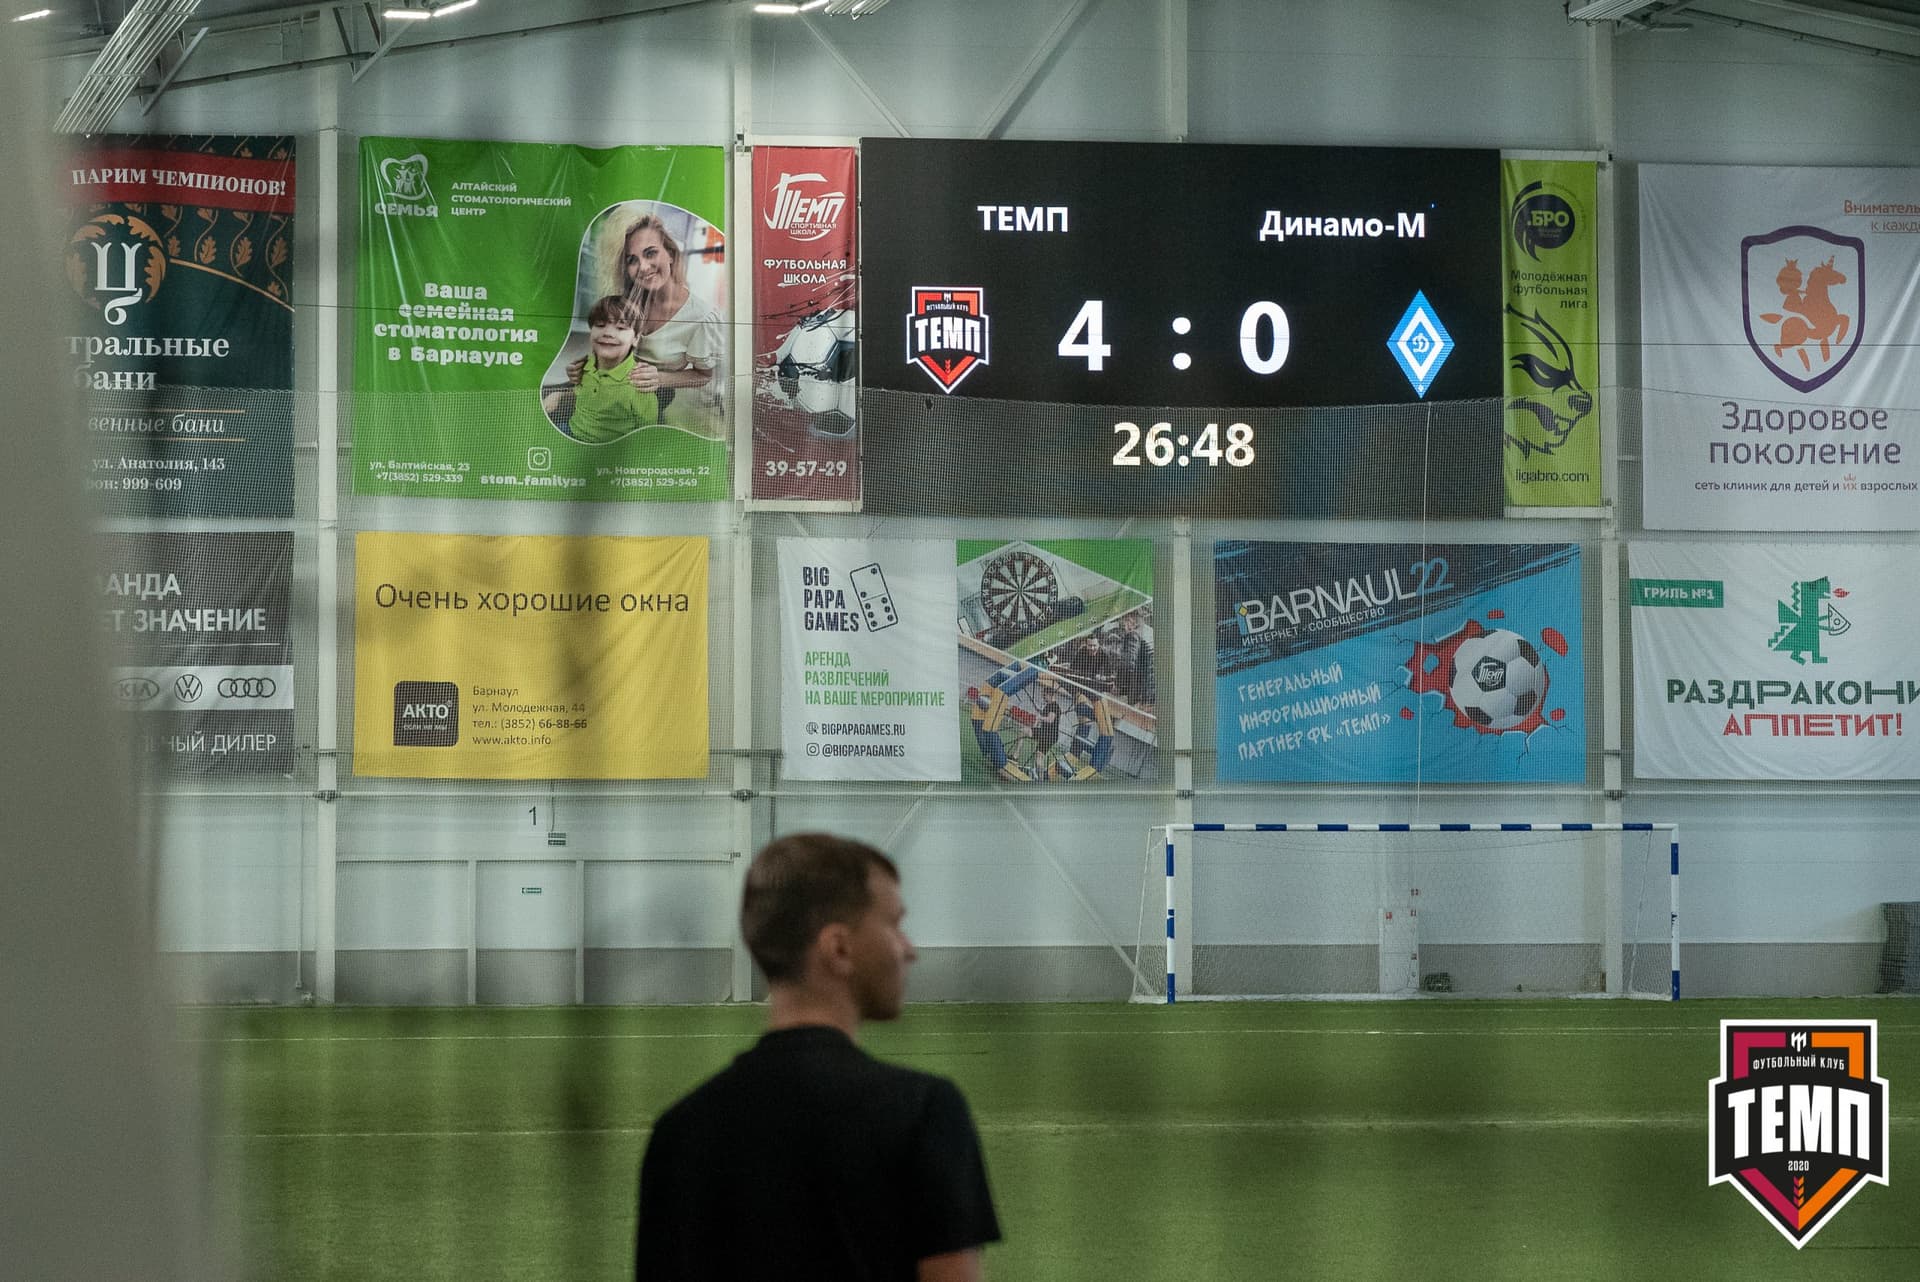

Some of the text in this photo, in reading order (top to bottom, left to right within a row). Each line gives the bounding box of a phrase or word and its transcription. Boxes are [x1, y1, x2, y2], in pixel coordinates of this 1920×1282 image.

[72, 168, 286, 196] ПАРИМ ЧЕМПИОНОВ!
[451, 182, 517, 193] АЛТАЙСКИЙ
[451, 195, 572, 206] СТОМАТОЛОГИЧЕСКИЙ
[374, 203, 439, 218] СЕМЬЯ
[451, 207, 486, 216] ЦЕНТР
[977, 205, 1069, 232] ТЕМП
[1259, 210, 1426, 242] Динамо-М
[1883, 221, 1920, 232] кажд
[763, 258, 847, 270] ФУТБОЛЬНАЯ
[783, 273, 827, 284] ШКОЛА
[424, 282, 488, 299] Ваша
[1512, 282, 1588, 297] футбольная
[399, 302, 514, 321] семейная
[1560, 300, 1588, 309] лига
[374, 323, 538, 342] стоматология
[915, 316, 980, 353] ТЕМП
[1058, 300, 1111, 371] 4
[1239, 301, 1290, 375] 0
[388, 346, 523, 367] в Барнауле
[172, 414, 225, 433] бани
[1722, 401, 1889, 434] Здоровое
[1112, 422, 1255, 467] 26:48
[1710, 442, 1901, 465] поколение
[118, 457, 198, 471] Анатолия,
[203, 458, 225, 470] 143
[370, 461, 385, 471] ул.
[615, 466, 695, 477] Новгородская,
[698, 466, 711, 475] 22
[766, 460, 847, 476] 39-57-29
[122, 477, 182, 491] 999-609
[1515, 468, 1590, 485] ligabro.com
[1694, 482, 1720, 491] сеть
[1723, 482, 1767, 491] клиник
[1770, 483, 1791, 493] для
[1794, 479, 1829, 493] детей
[1832, 482, 1840, 491] и
[1860, 482, 1919, 493] взрослых
[803, 566, 830, 587] BIG
[375, 583, 689, 616] Очень хорошие окна
[803, 588, 846, 609] PAPA
[1644, 587, 1688, 599] ГРИЛЬ
[133, 608, 266, 632] ЗНАЧЕНИЕ
[804, 611, 860, 632] GAMES
[1241, 626, 1299, 647] ИНТЕРНЕТ
[1308, 606, 1385, 633] СООБЩЕСТВО
[805, 651, 851, 668] АРЕНДА
[805, 669, 889, 687] РАЗВЛЕЧЕНИЙ
[1238, 661, 1344, 703] ГЕНЕРАЛЬНЫЙ
[472, 685, 519, 698] Барнаул
[805, 690, 945, 707] НА ВАШЕ МЕРОПРИЯТИЕ
[403, 703, 449, 719] АКТО
[472, 702, 585, 714] ул. Молодежная, 44
[1239, 681, 1382, 734] ИНФОРМАЦИОННЫЙ
[472, 720, 498, 729] тел.:
[501, 719, 536, 730] (3852)
[821, 723, 906, 736] BIGPAPAGAMES.RU
[1723, 712, 1903, 737] АППЕТИТ!
[211, 734, 276, 755] ДИЛЕР
[472, 734, 552, 745] www.akto.info
[1238, 711, 1391, 761] ПАРТНЕР ФК «ТЕМП»
[822, 744, 905, 757] @BIGPAPAGAMES
[528, 805, 537, 826] 1
